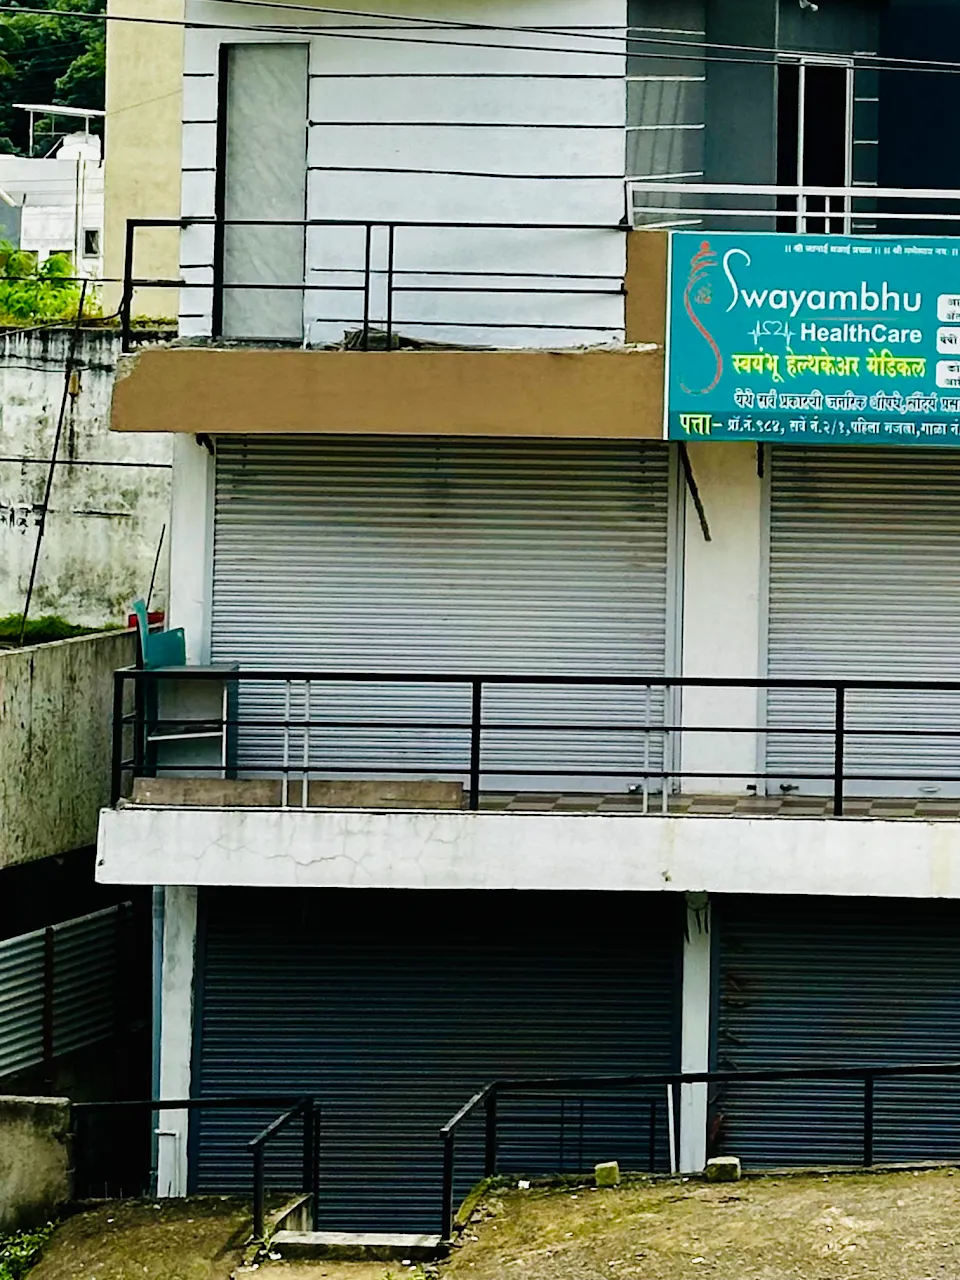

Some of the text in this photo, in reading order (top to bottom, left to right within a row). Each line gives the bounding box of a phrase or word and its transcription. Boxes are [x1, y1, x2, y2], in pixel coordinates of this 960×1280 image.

[723, 249, 922, 317] Swayambhu
[800, 322, 922, 344] HealthCare
[731, 347, 926, 382] स्वयंभू हेल्थकेअर मेडिकल
